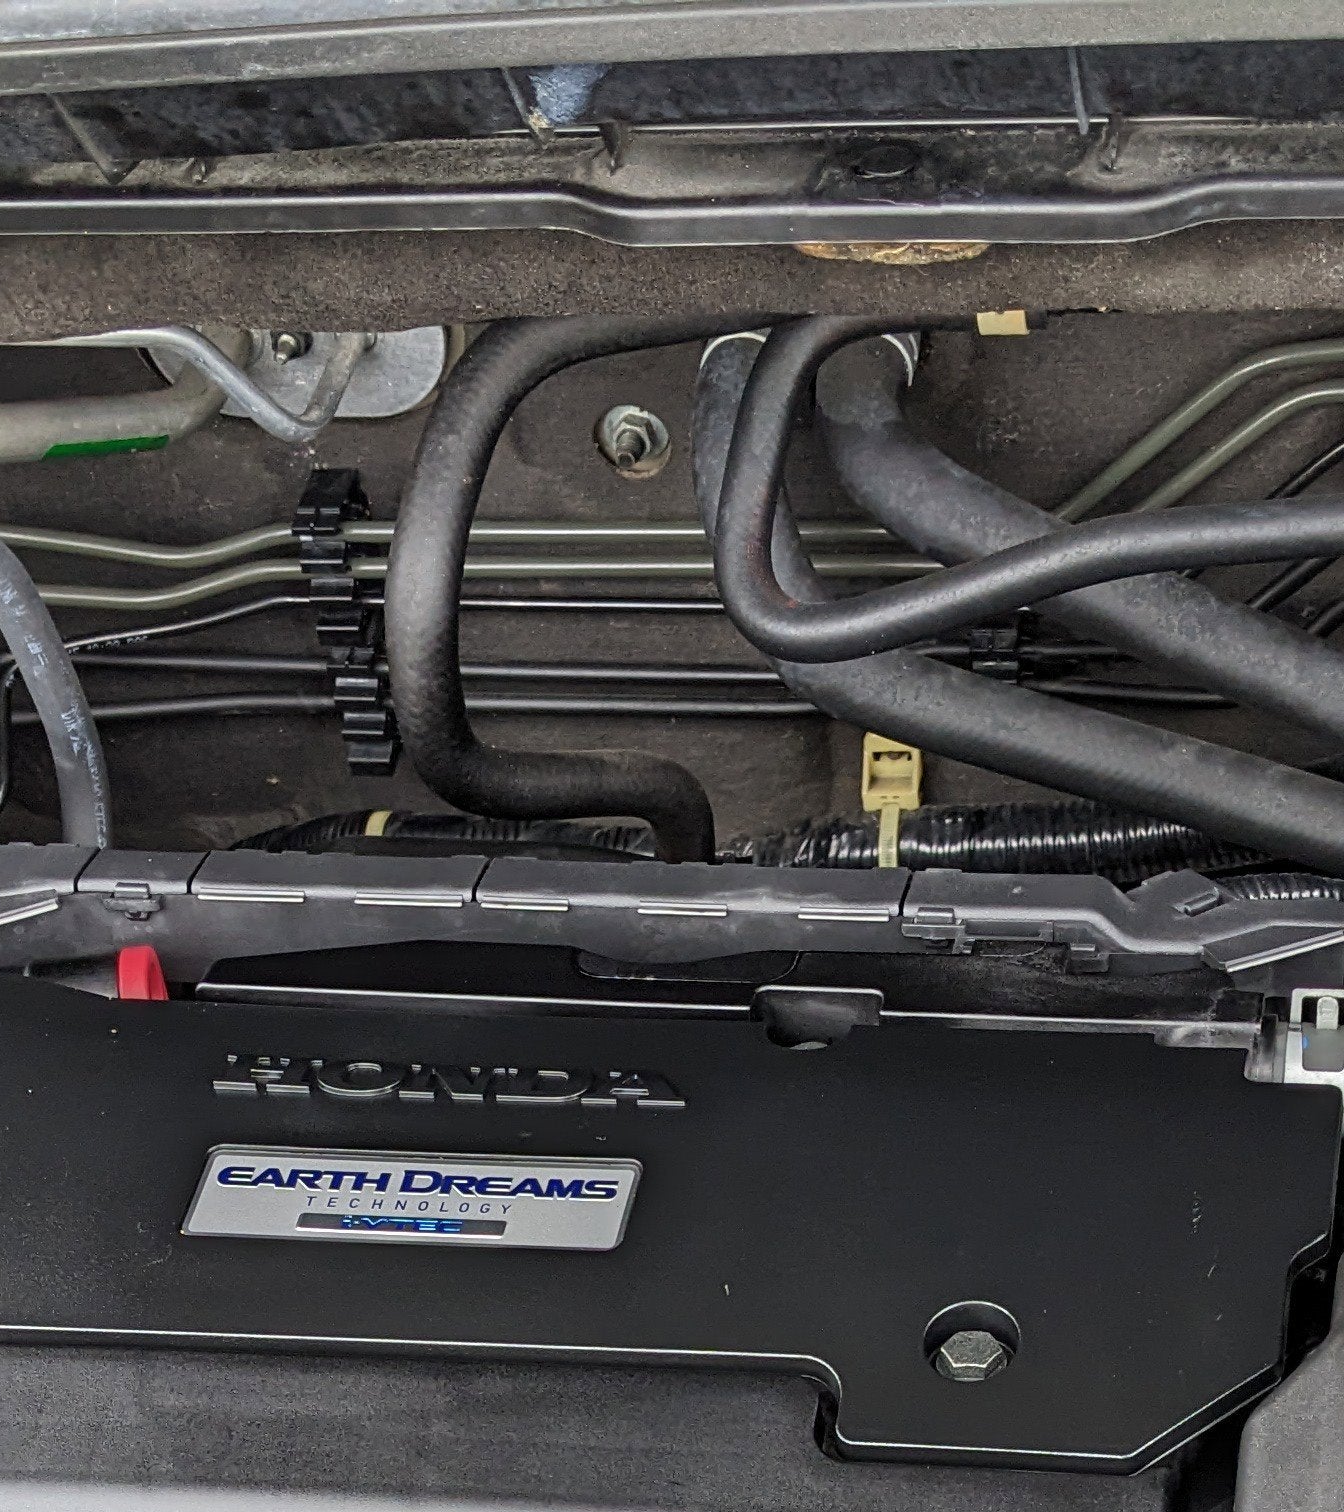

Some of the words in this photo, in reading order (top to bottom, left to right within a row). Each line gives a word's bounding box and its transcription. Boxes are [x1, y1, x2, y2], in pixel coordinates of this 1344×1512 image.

[212, 1053, 687, 1108] HONDA
[215, 1164, 392, 1196] EARTH
[398, 1168, 620, 1203] DREAMS
[305, 1194, 514, 1216] TECHNOLOGY
